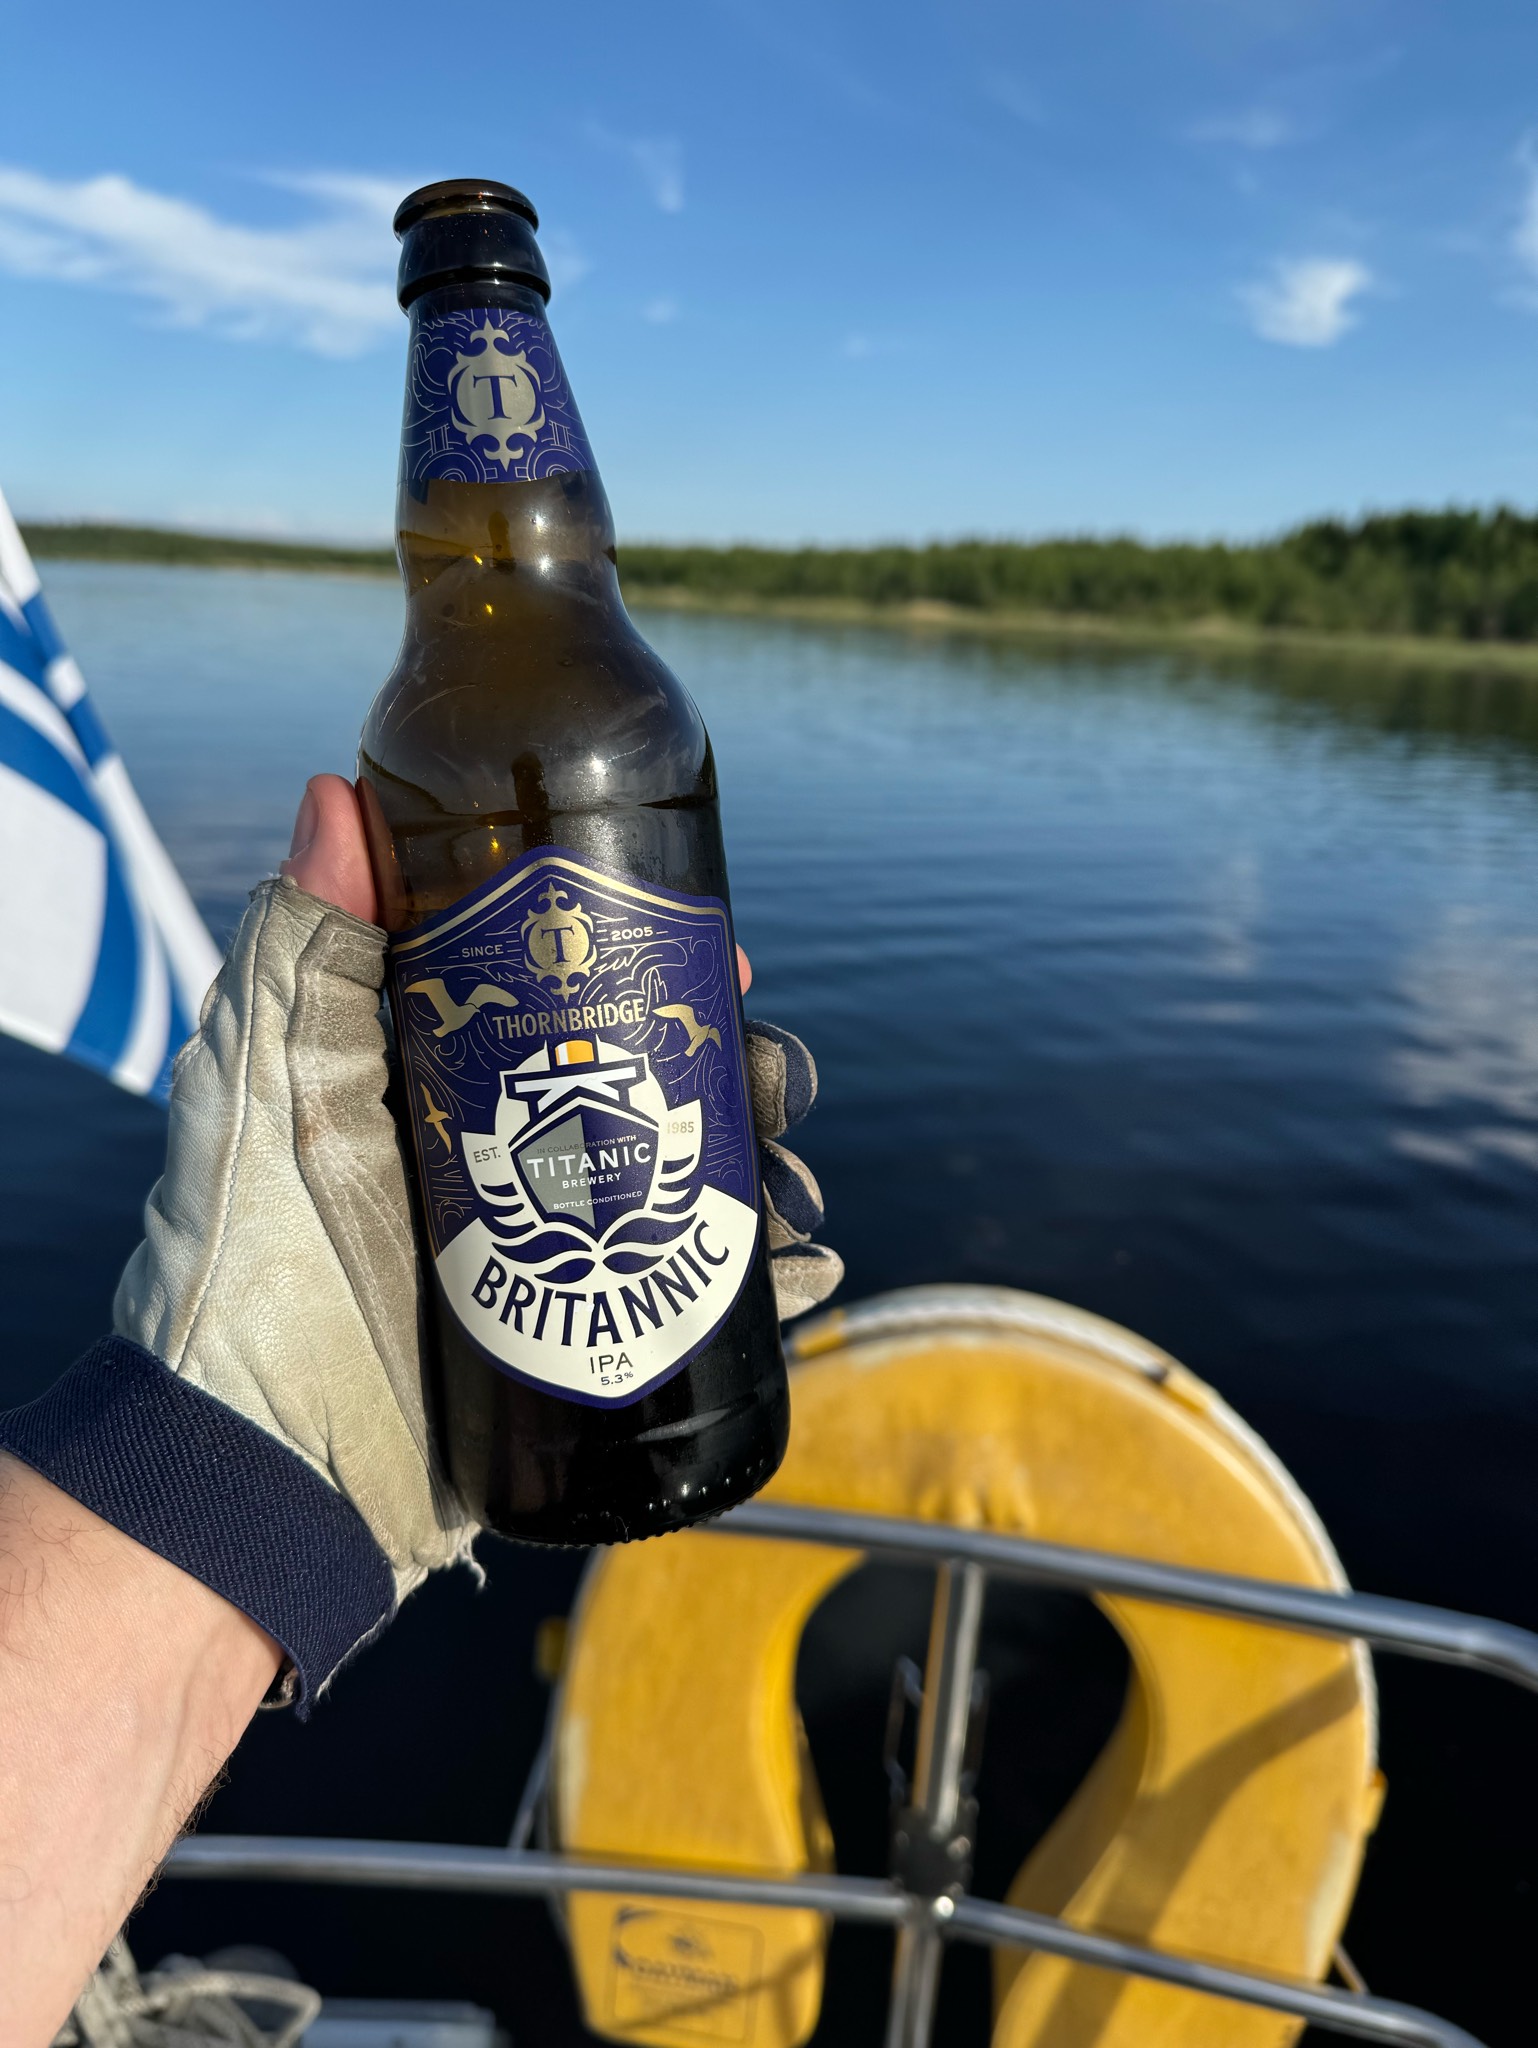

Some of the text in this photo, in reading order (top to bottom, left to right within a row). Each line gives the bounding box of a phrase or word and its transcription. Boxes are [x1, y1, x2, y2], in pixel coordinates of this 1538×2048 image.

[473, 375, 518, 420] T
[461, 925, 654, 959] SINCE 2005
[541, 925, 575, 964] T
[492, 998, 647, 1040] THORNBRIDGE
[666, 1121, 695, 1135] 1985
[473, 1146, 501, 1164] EST.
[547, 1138, 616, 1153] COLLABORATION
[616, 1134, 637, 1144] WITH
[526, 1142, 652, 1179] TITANIC
[562, 1172, 622, 1189] BREWERY
[553, 1190, 643, 1210] BOTTLE CONDITIONED
[471, 1220, 730, 1348] BRITANNIC
[589, 1351, 634, 1375] IPA
[600, 1371, 634, 1386] 5.3%
